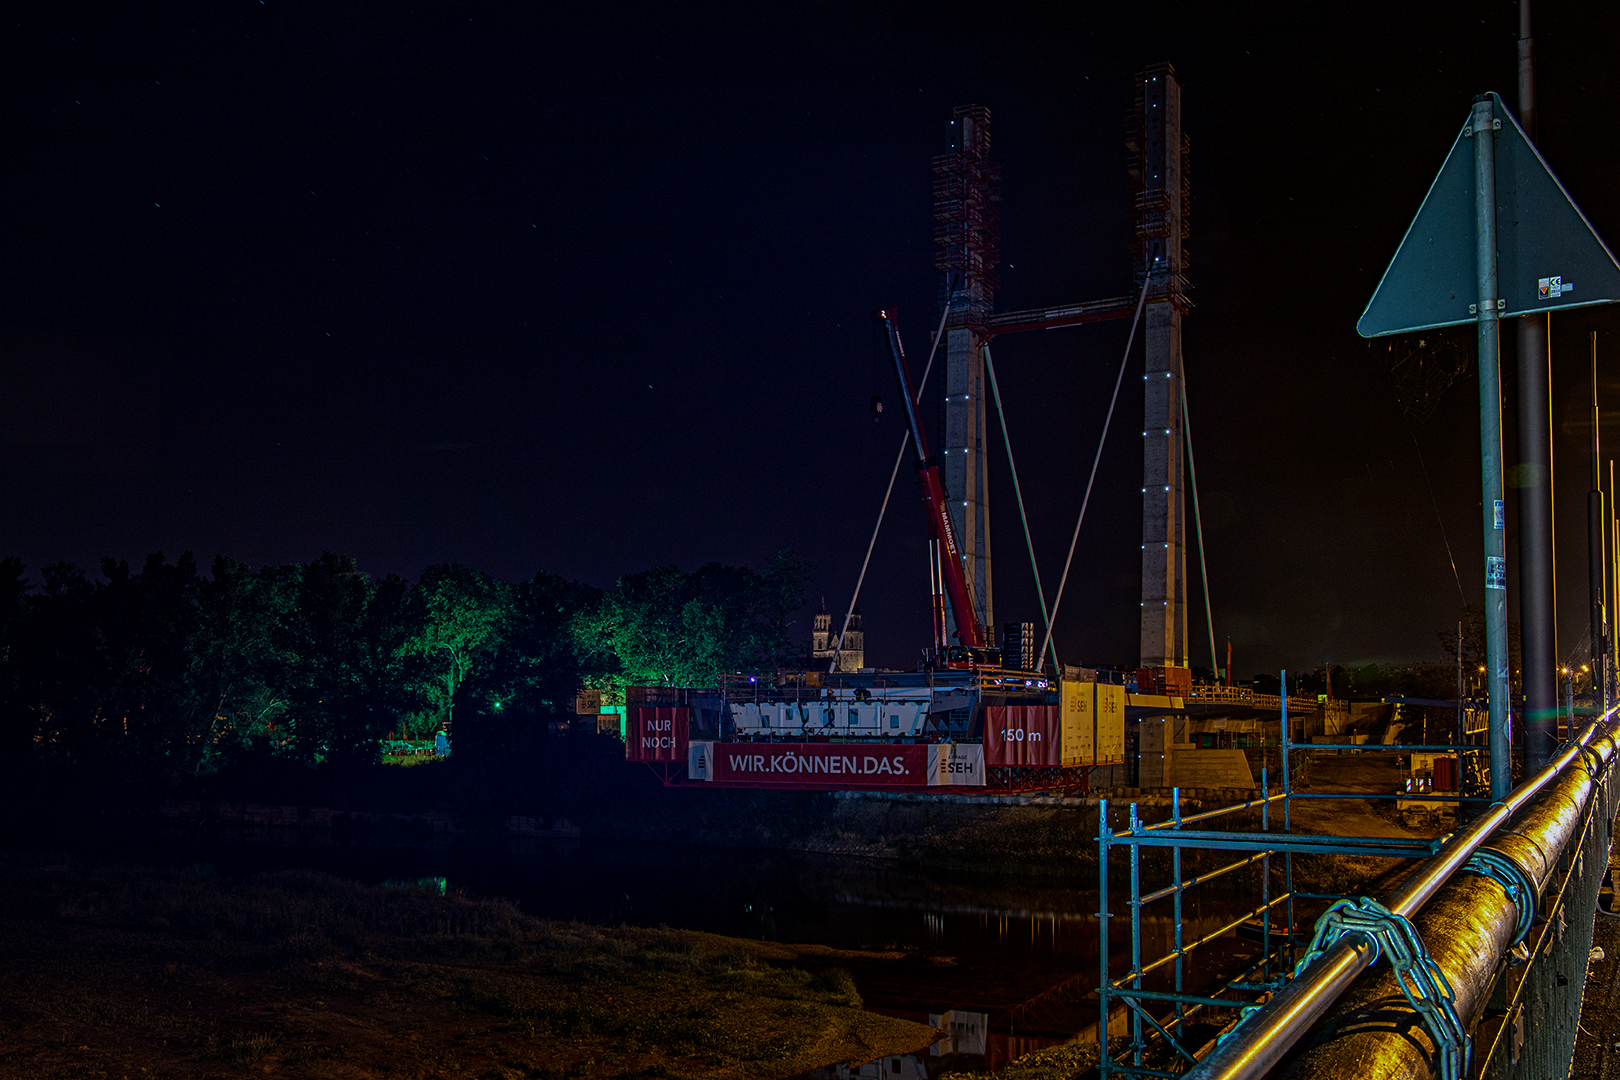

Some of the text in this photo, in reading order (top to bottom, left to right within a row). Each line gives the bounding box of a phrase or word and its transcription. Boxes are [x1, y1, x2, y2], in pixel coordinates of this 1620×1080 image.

[941, 512, 957, 554] MAMMOET
[647, 720, 671, 732] NUR
[1001, 728, 1041, 742] 150 m
[641, 736, 676, 749] NOCH
[729, 751, 910, 774] WIR.KÖNNEN.DAS.
[947, 762, 972, 774] SEH
